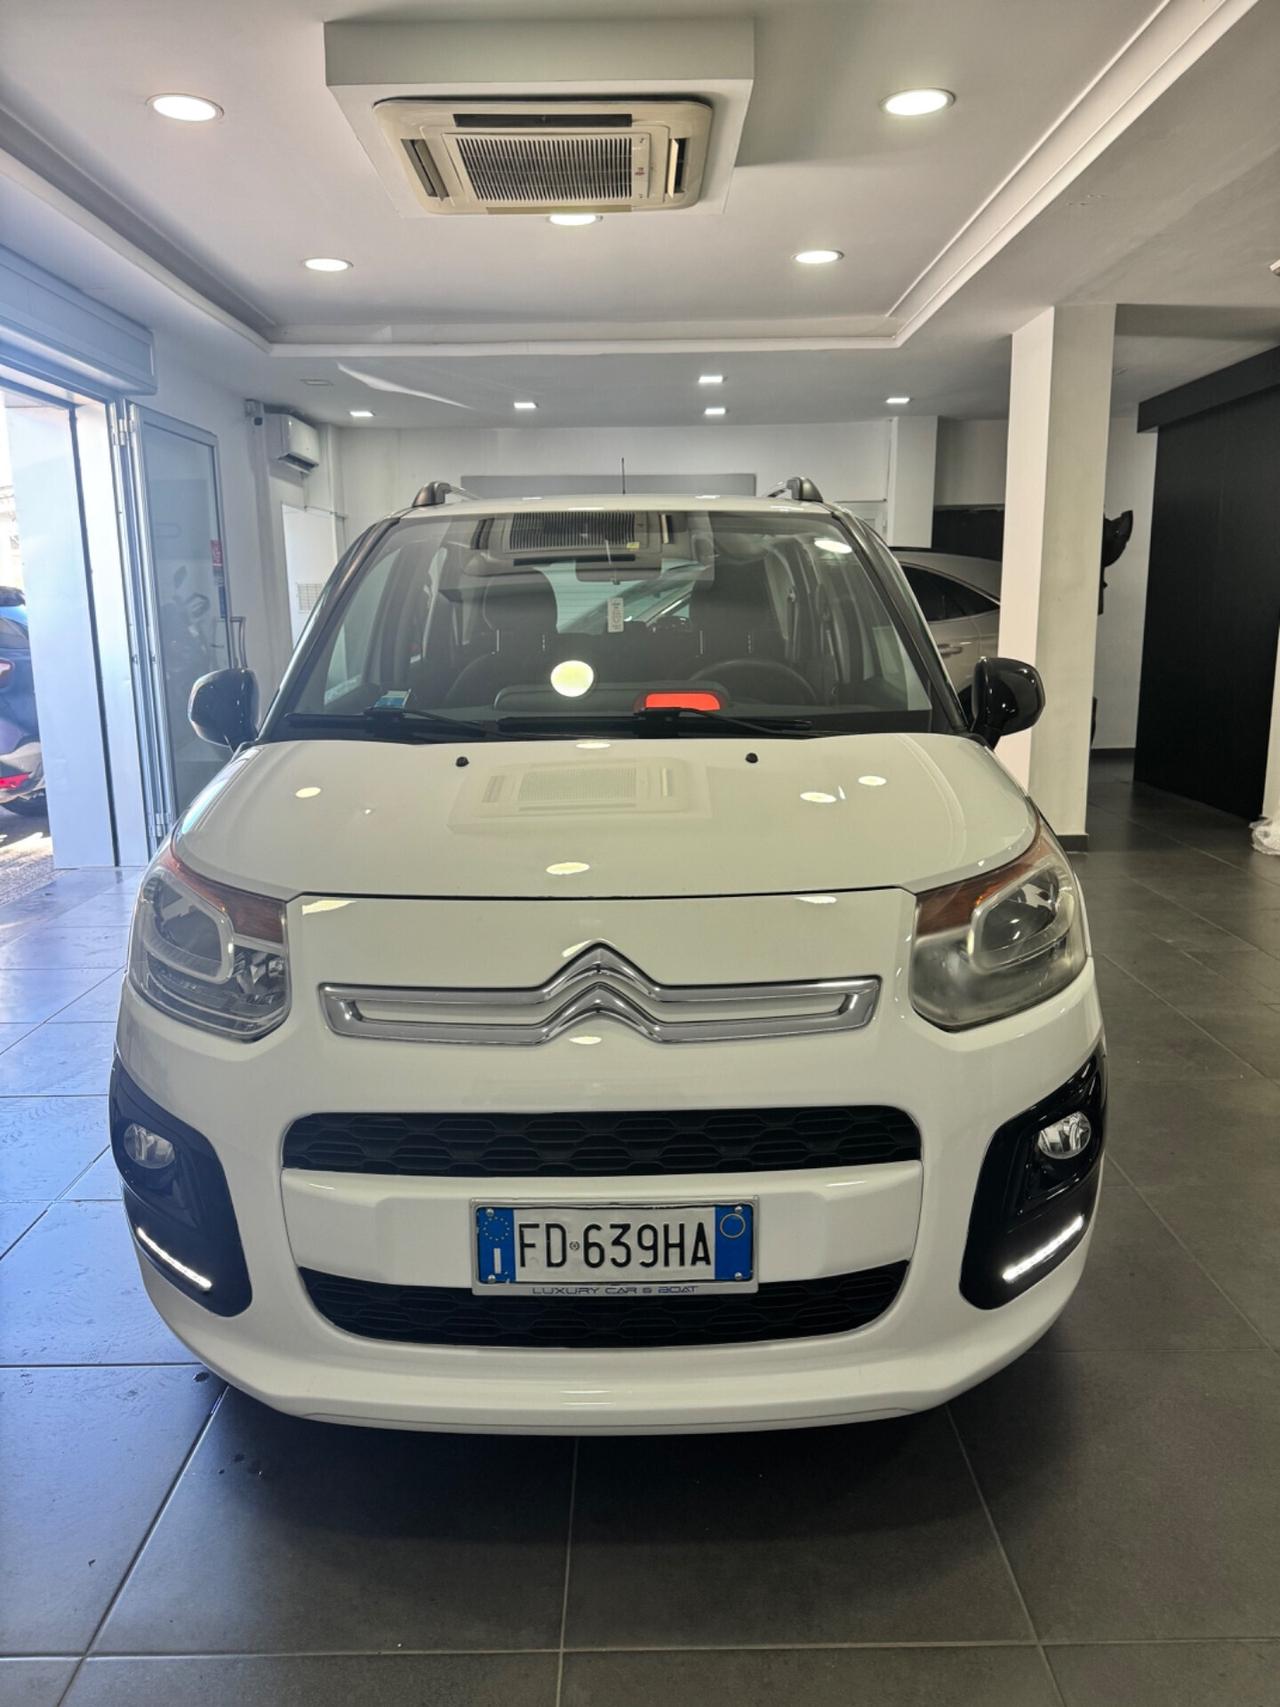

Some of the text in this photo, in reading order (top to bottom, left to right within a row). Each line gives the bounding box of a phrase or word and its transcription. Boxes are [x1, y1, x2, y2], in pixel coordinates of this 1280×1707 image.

[532, 1286, 600, 1295] LUXURY
[605, 1286, 638, 1295] CAR
[658, 1285, 699, 1294] BOAT
